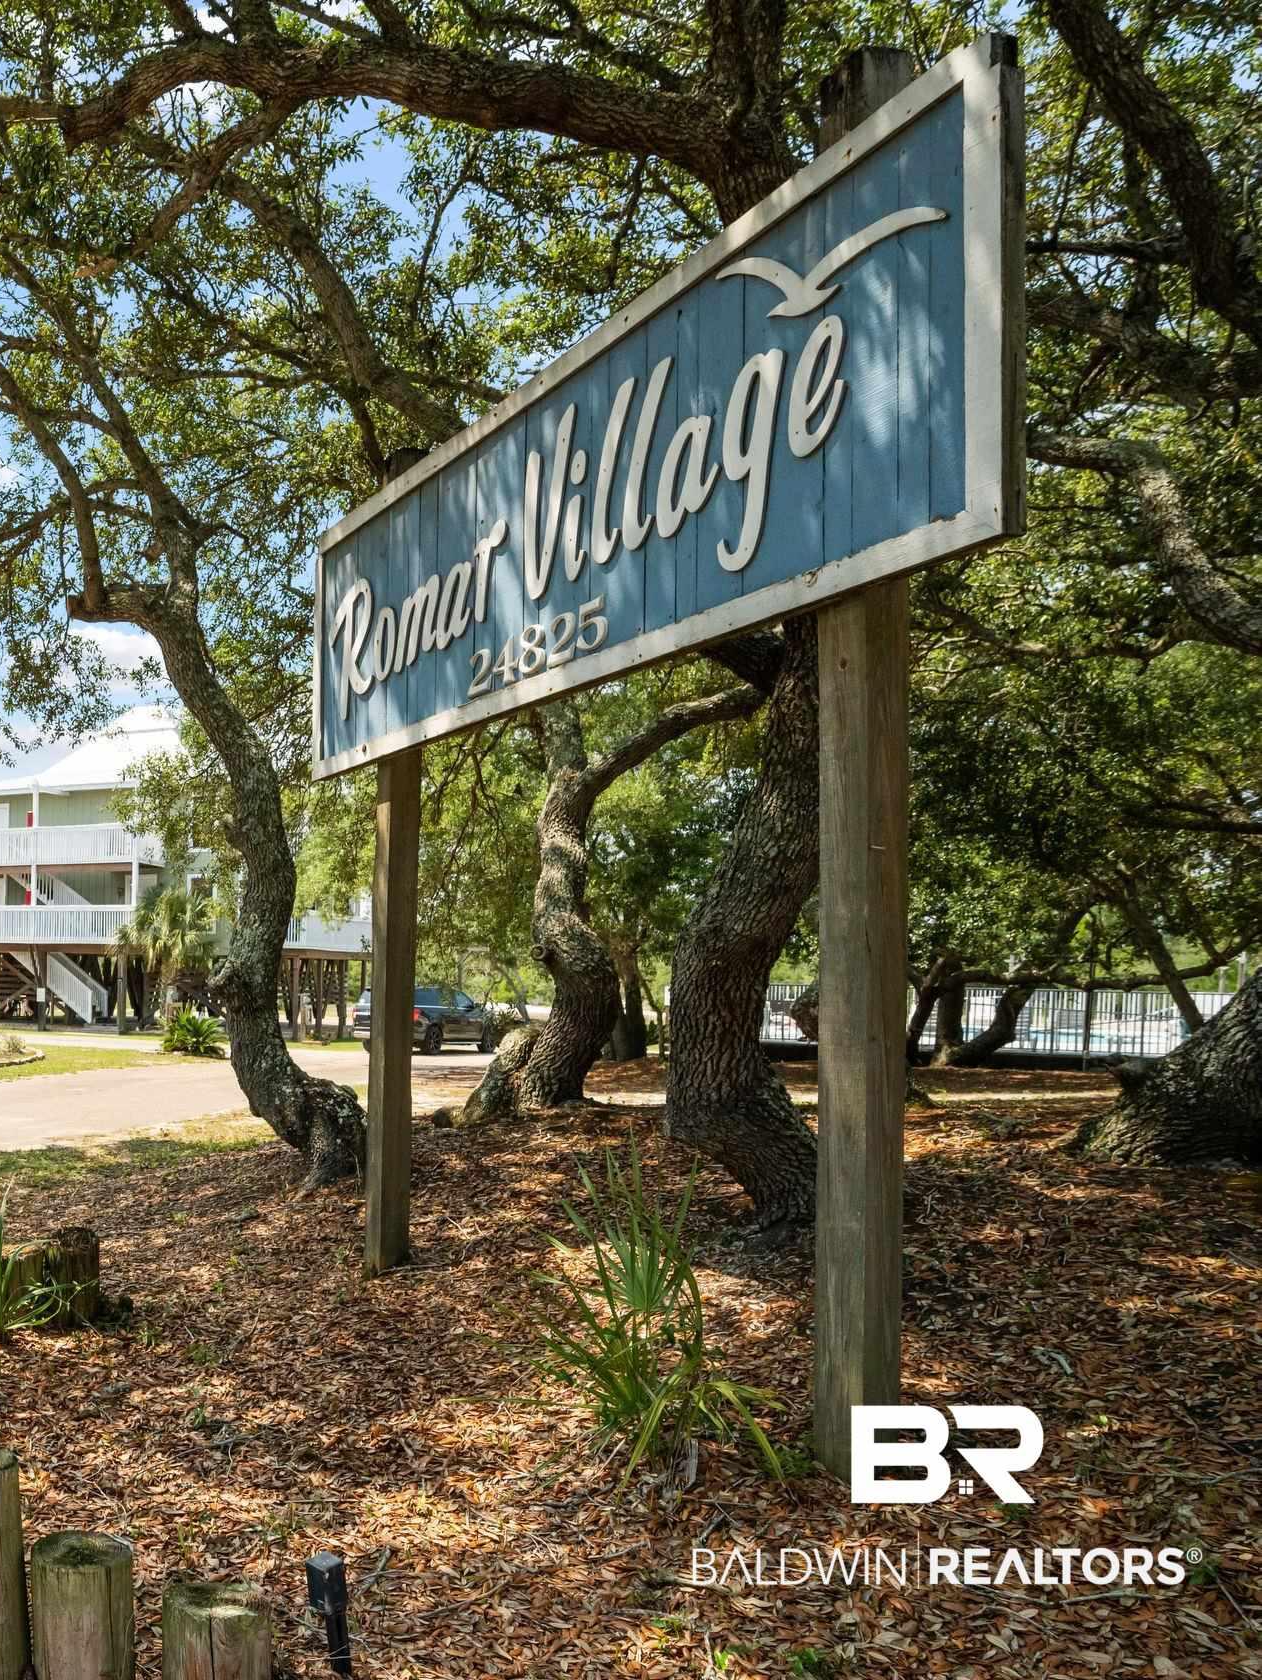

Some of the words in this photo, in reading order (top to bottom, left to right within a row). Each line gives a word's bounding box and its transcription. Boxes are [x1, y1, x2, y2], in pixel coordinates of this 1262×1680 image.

[329, 518, 509, 721] Romar
[523, 314, 849, 601] Village
[467, 594, 609, 699] 24825
